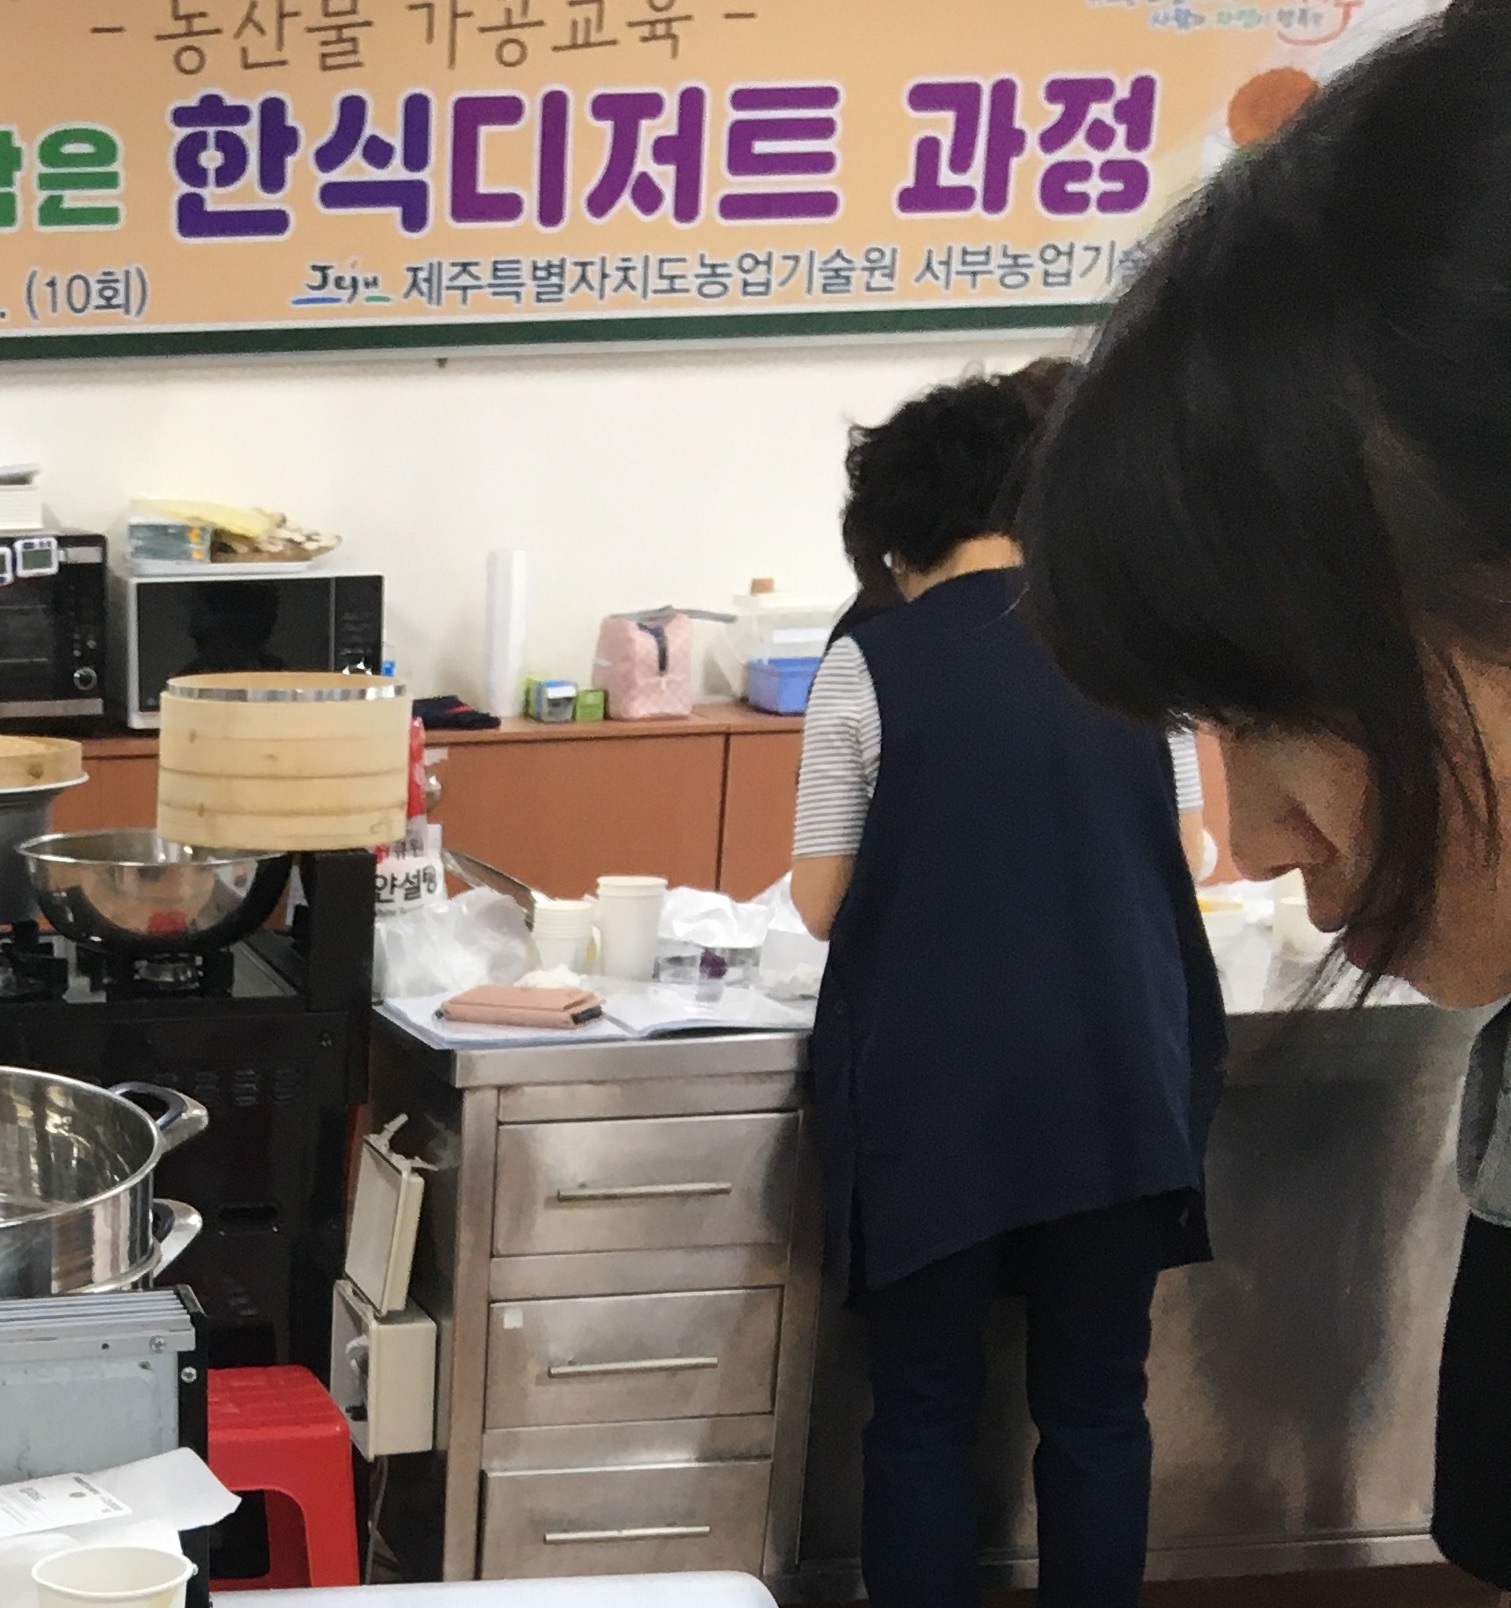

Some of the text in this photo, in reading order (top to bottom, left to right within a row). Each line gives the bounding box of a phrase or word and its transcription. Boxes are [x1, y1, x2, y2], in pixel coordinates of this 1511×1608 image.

[154, 0, 375, 76] 농산물
[406, 0, 695, 70] 가공교육
[171, 82, 842, 239] 한식디저트
[896, 72, 1158, 217] 과정
[25, 267, 149, 320] (10회)
[404, 246, 898, 304] 제주특별자치도농업기술원
